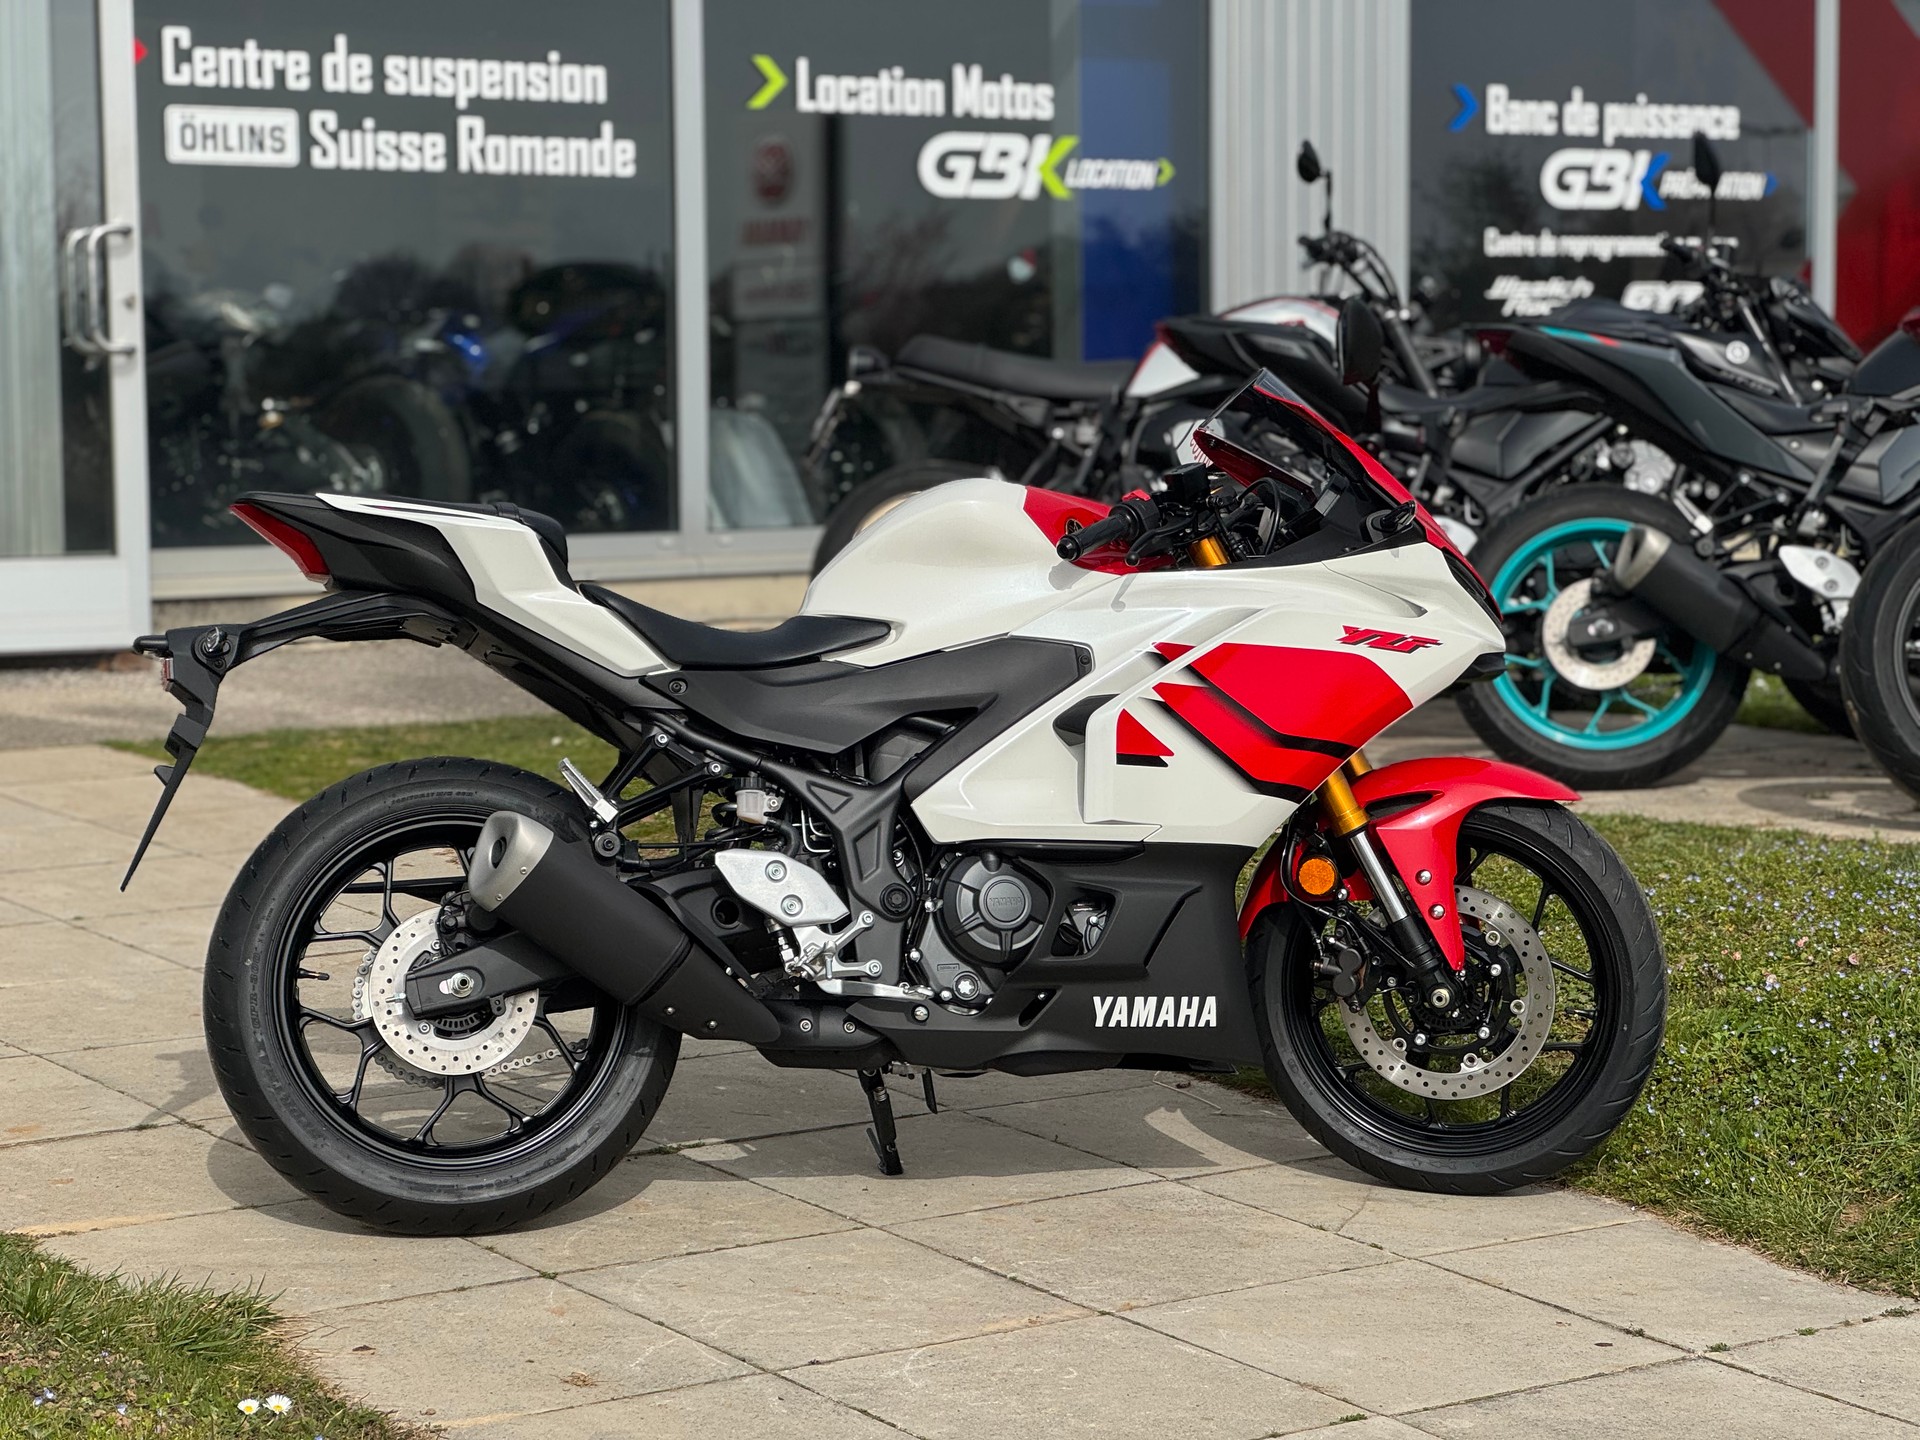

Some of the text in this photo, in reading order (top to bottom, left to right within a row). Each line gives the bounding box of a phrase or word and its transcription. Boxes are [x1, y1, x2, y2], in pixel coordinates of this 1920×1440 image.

[161, 25, 608, 110] Centre de suspension
[796, 56, 1055, 120] Location Motos
[180, 109, 637, 178] ÖHLINS Suisse Romande
[1486, 83, 1741, 147] Banc de puissance
[917, 130, 1158, 200] GBK LOCATION
[1540, 148, 1672, 211] GBK
[1092, 996, 1217, 1028] YAMAHA
